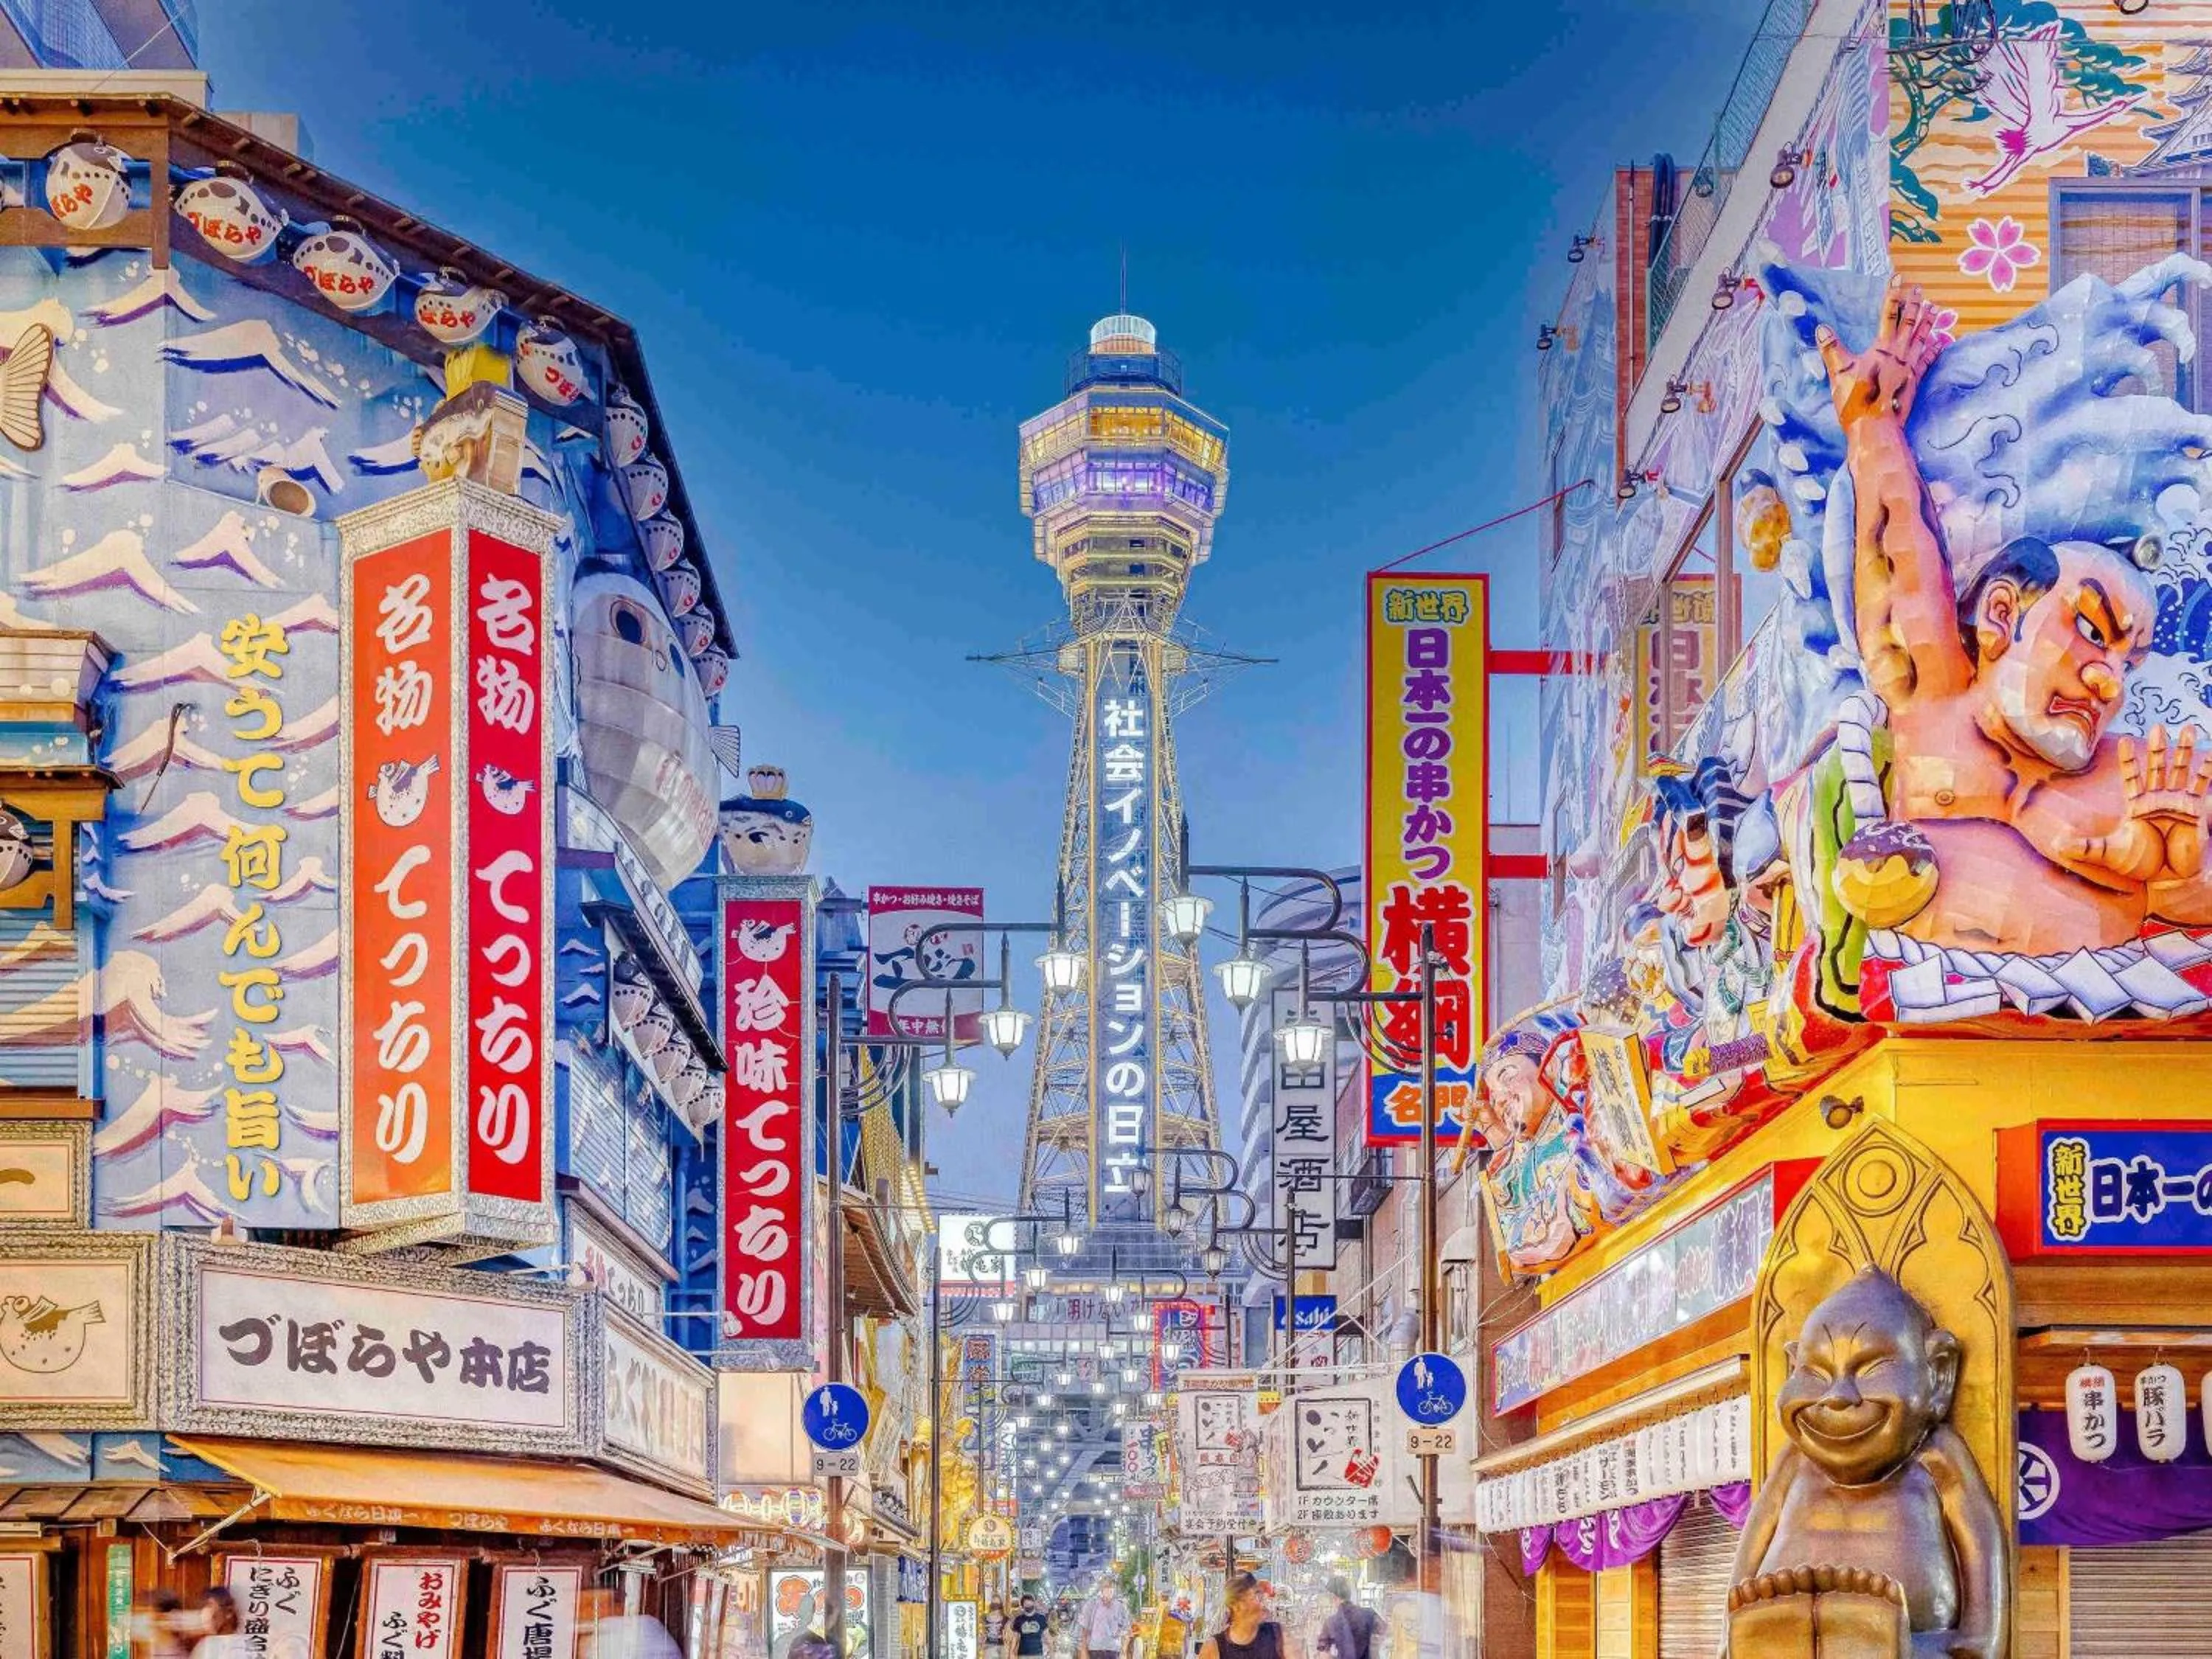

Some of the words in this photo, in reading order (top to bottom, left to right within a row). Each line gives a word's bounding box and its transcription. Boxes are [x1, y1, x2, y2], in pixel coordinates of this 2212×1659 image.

[1386, 589, 1469, 624] 新世界
[1402, 629, 1452, 879] 日本一の串かつ
[218, 613, 289, 1202] 安うて何んでも旨い
[1104, 700, 1145, 1192] 社会イノベーションの日立
[899, 1020, 947, 1034] 年中無
[2053, 1142, 2087, 1237] 新世界
[219, 1313, 552, 1394] づぼらや本店
[2084, 1391, 2107, 1449] 串かつ
[1298, 1496, 1309, 1506] 1F
[1312, 1495, 1379, 1506] カウンター席
[1298, 1510, 1309, 1520] 2F
[245, 1567, 274, 1659] にぎり盛合
[275, 1566, 301, 1615] ふぐ
[415, 1572, 443, 1649] おみやげ
